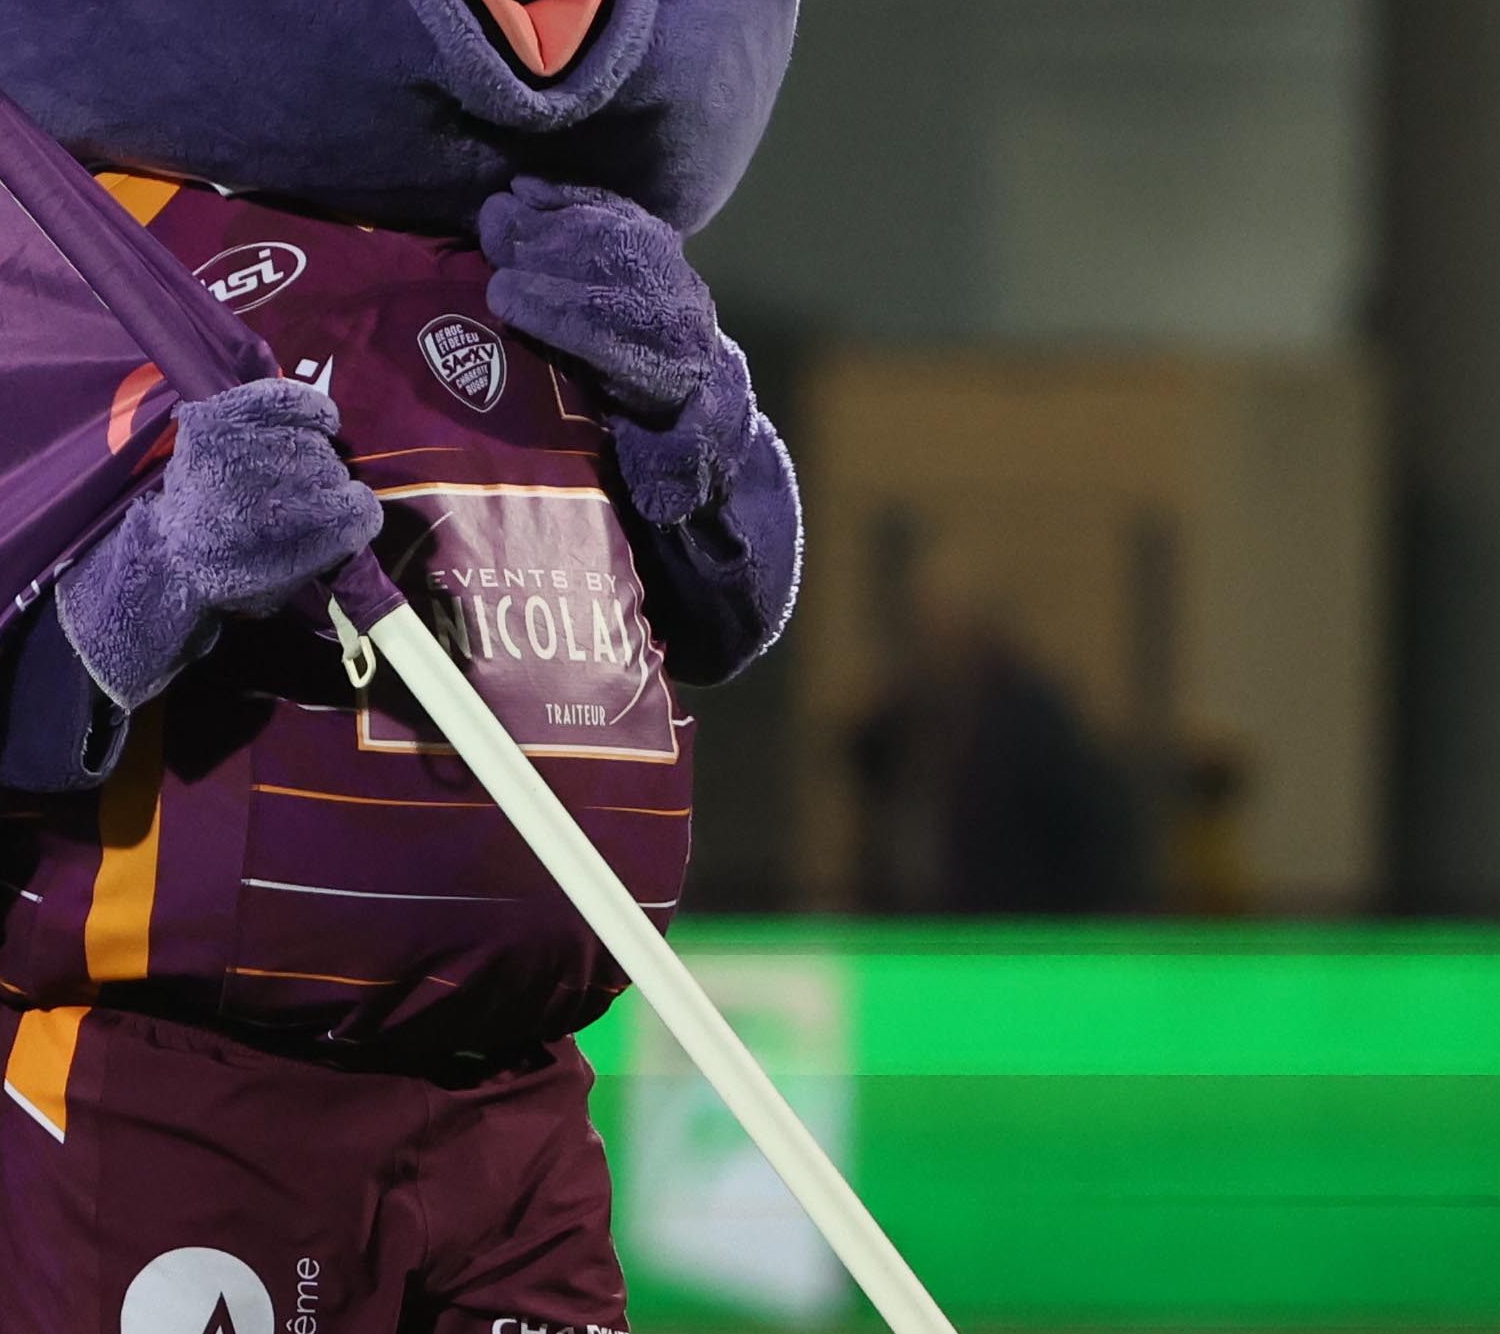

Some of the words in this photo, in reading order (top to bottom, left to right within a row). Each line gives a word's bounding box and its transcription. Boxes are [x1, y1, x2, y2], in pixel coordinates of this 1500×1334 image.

[428, 568, 569, 590] EVENTS
[585, 570, 616, 593] BY
[545, 703, 606, 727] TRAITEUR
